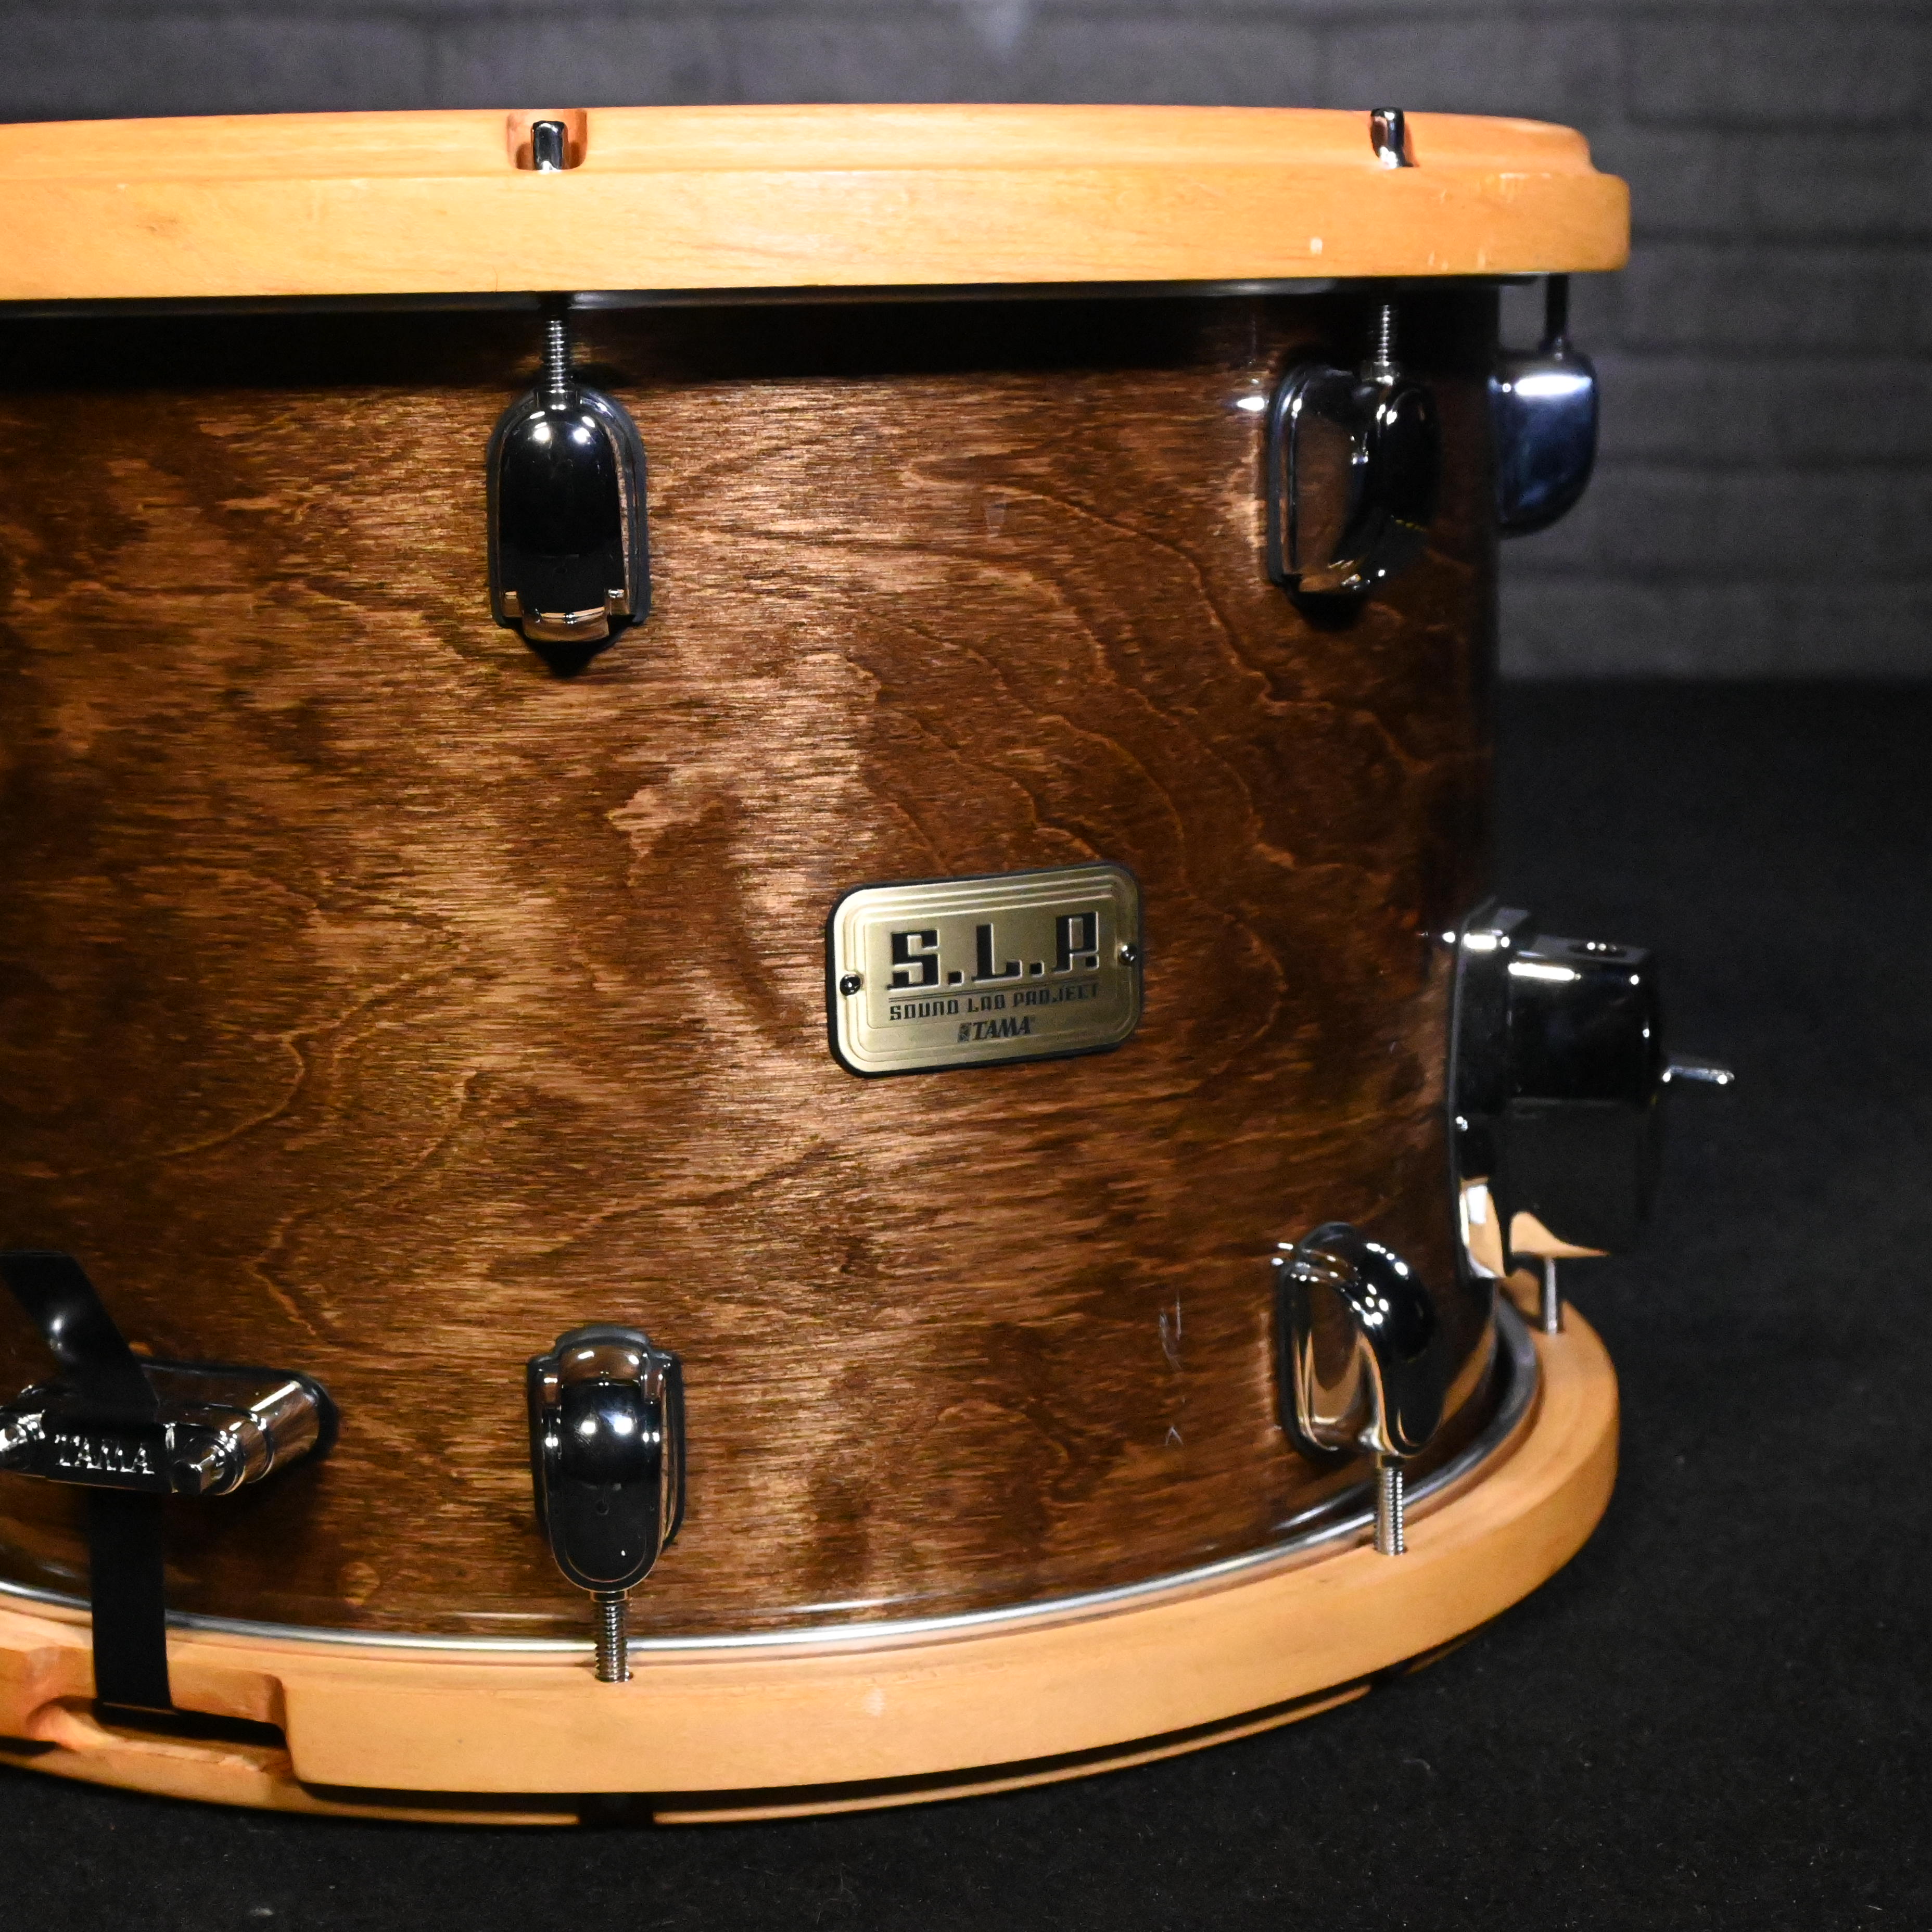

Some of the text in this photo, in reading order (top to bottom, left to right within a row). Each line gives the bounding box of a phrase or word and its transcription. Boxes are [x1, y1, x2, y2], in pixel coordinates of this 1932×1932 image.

[889, 983, 1099, 1021] SOUND LAB PROJECT
[972, 1015, 1032, 1041] TAMA
[54, 1433, 155, 1475] TAMA
